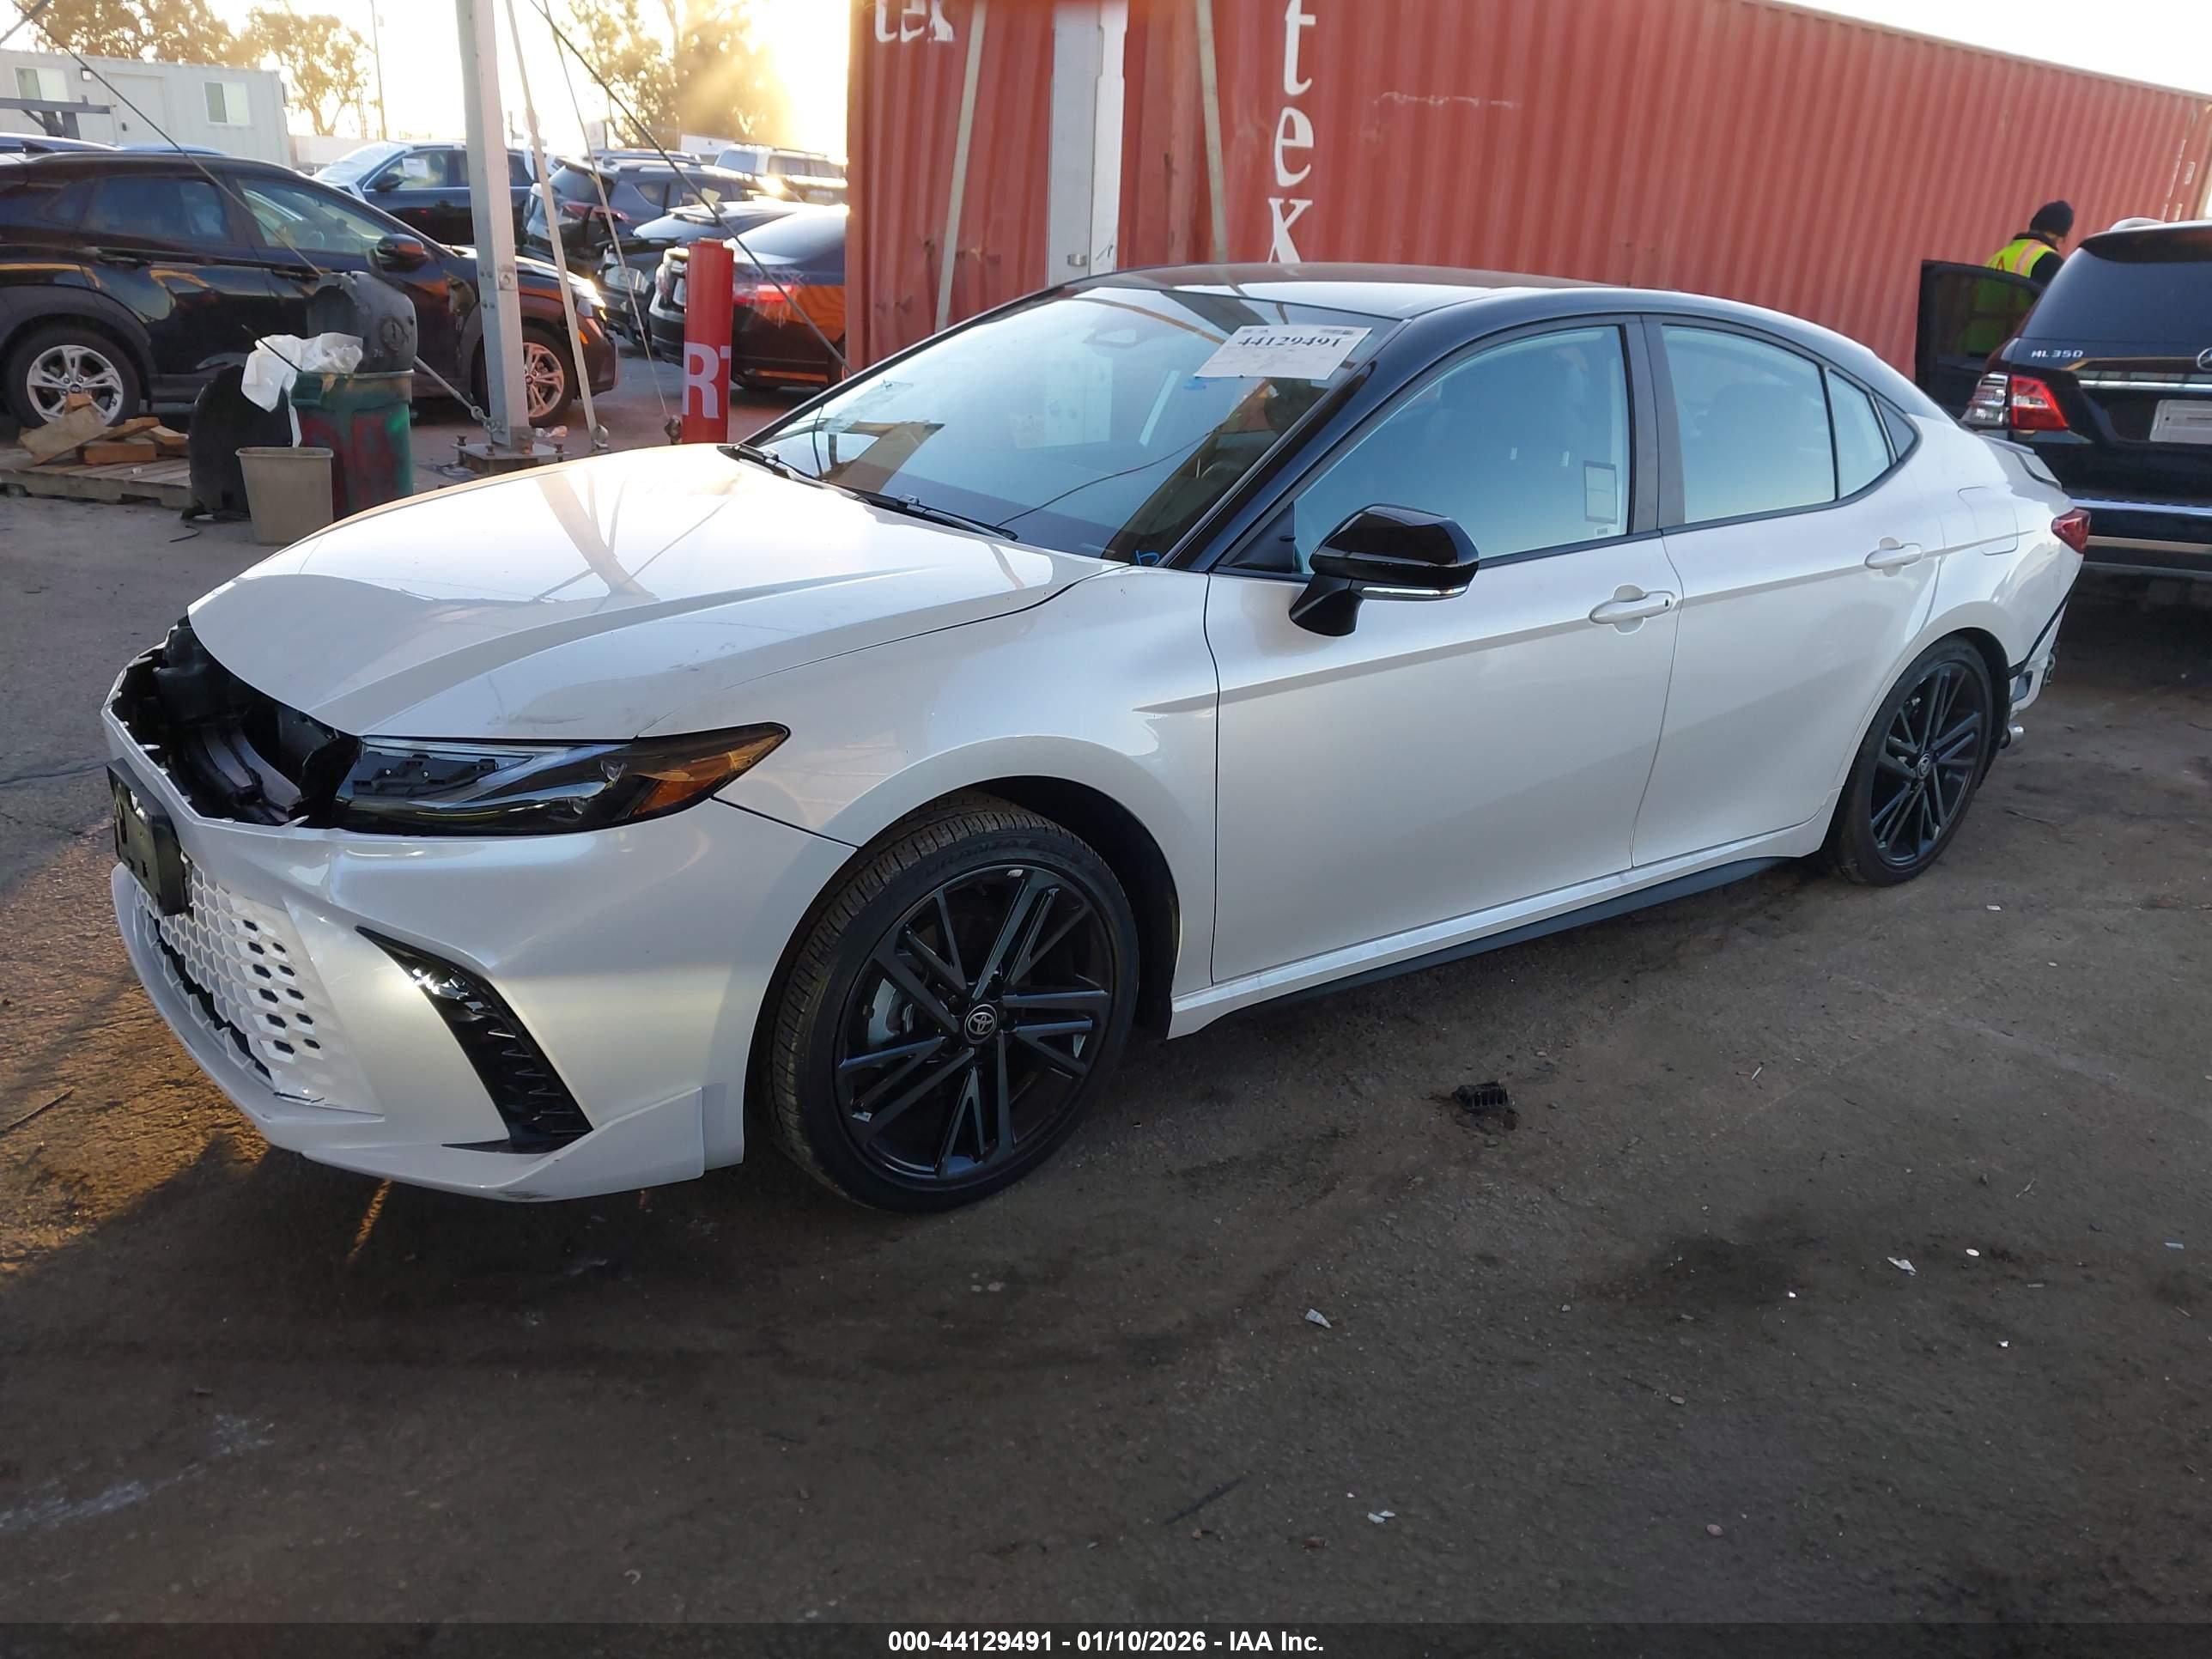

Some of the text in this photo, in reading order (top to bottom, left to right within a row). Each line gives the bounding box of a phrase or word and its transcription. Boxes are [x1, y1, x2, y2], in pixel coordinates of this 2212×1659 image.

[1237, 336, 1342, 348] 44129491
[2031, 349, 2084, 358] ML 350
